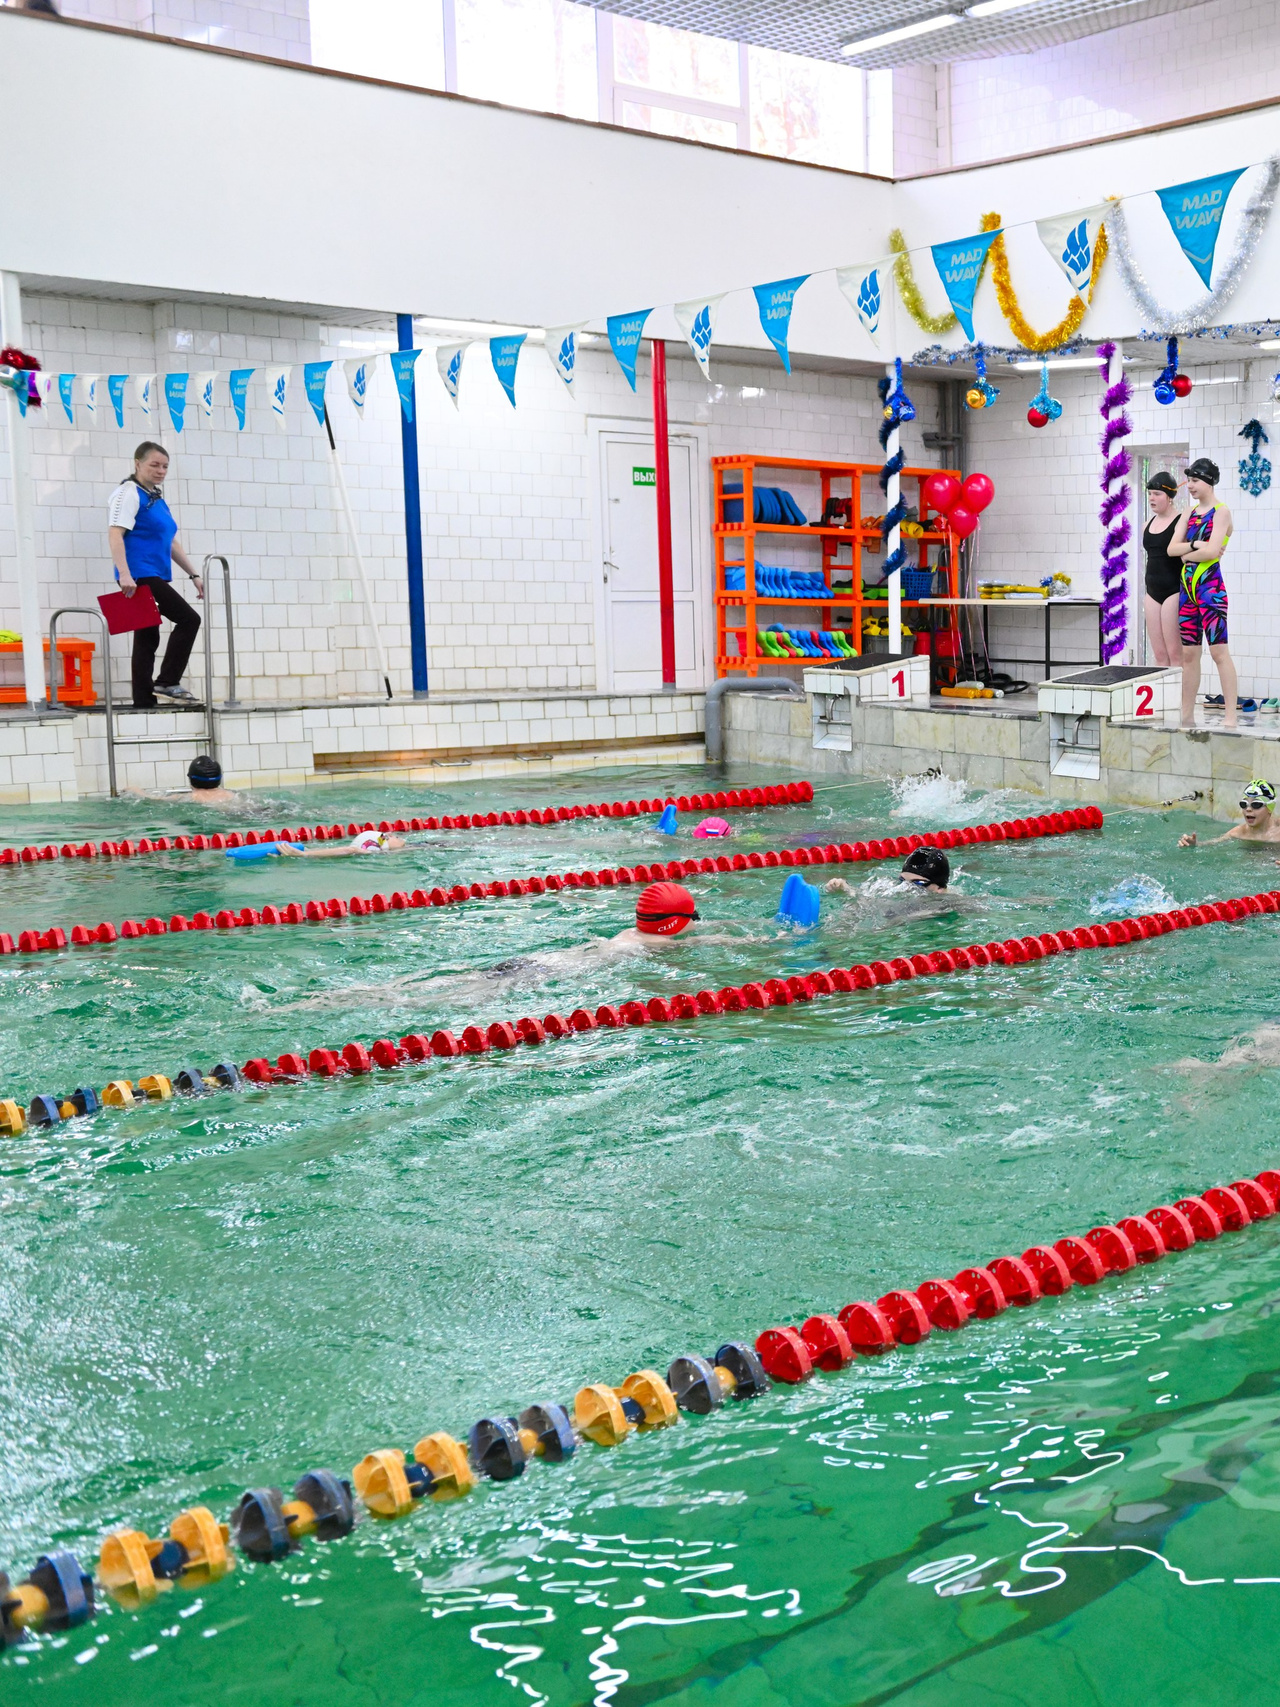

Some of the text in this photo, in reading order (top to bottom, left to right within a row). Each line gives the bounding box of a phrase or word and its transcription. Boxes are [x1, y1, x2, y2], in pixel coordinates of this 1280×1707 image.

[1181, 189, 1223, 212] MAD
[951, 247, 983, 267] MAD
[616, 334, 640, 346] WAV
[634, 471, 656, 483] ВЫХ
[891, 669, 905, 697] 1
[1135, 685, 1154, 717] 2
[657, 918, 679, 933] CLIFF
